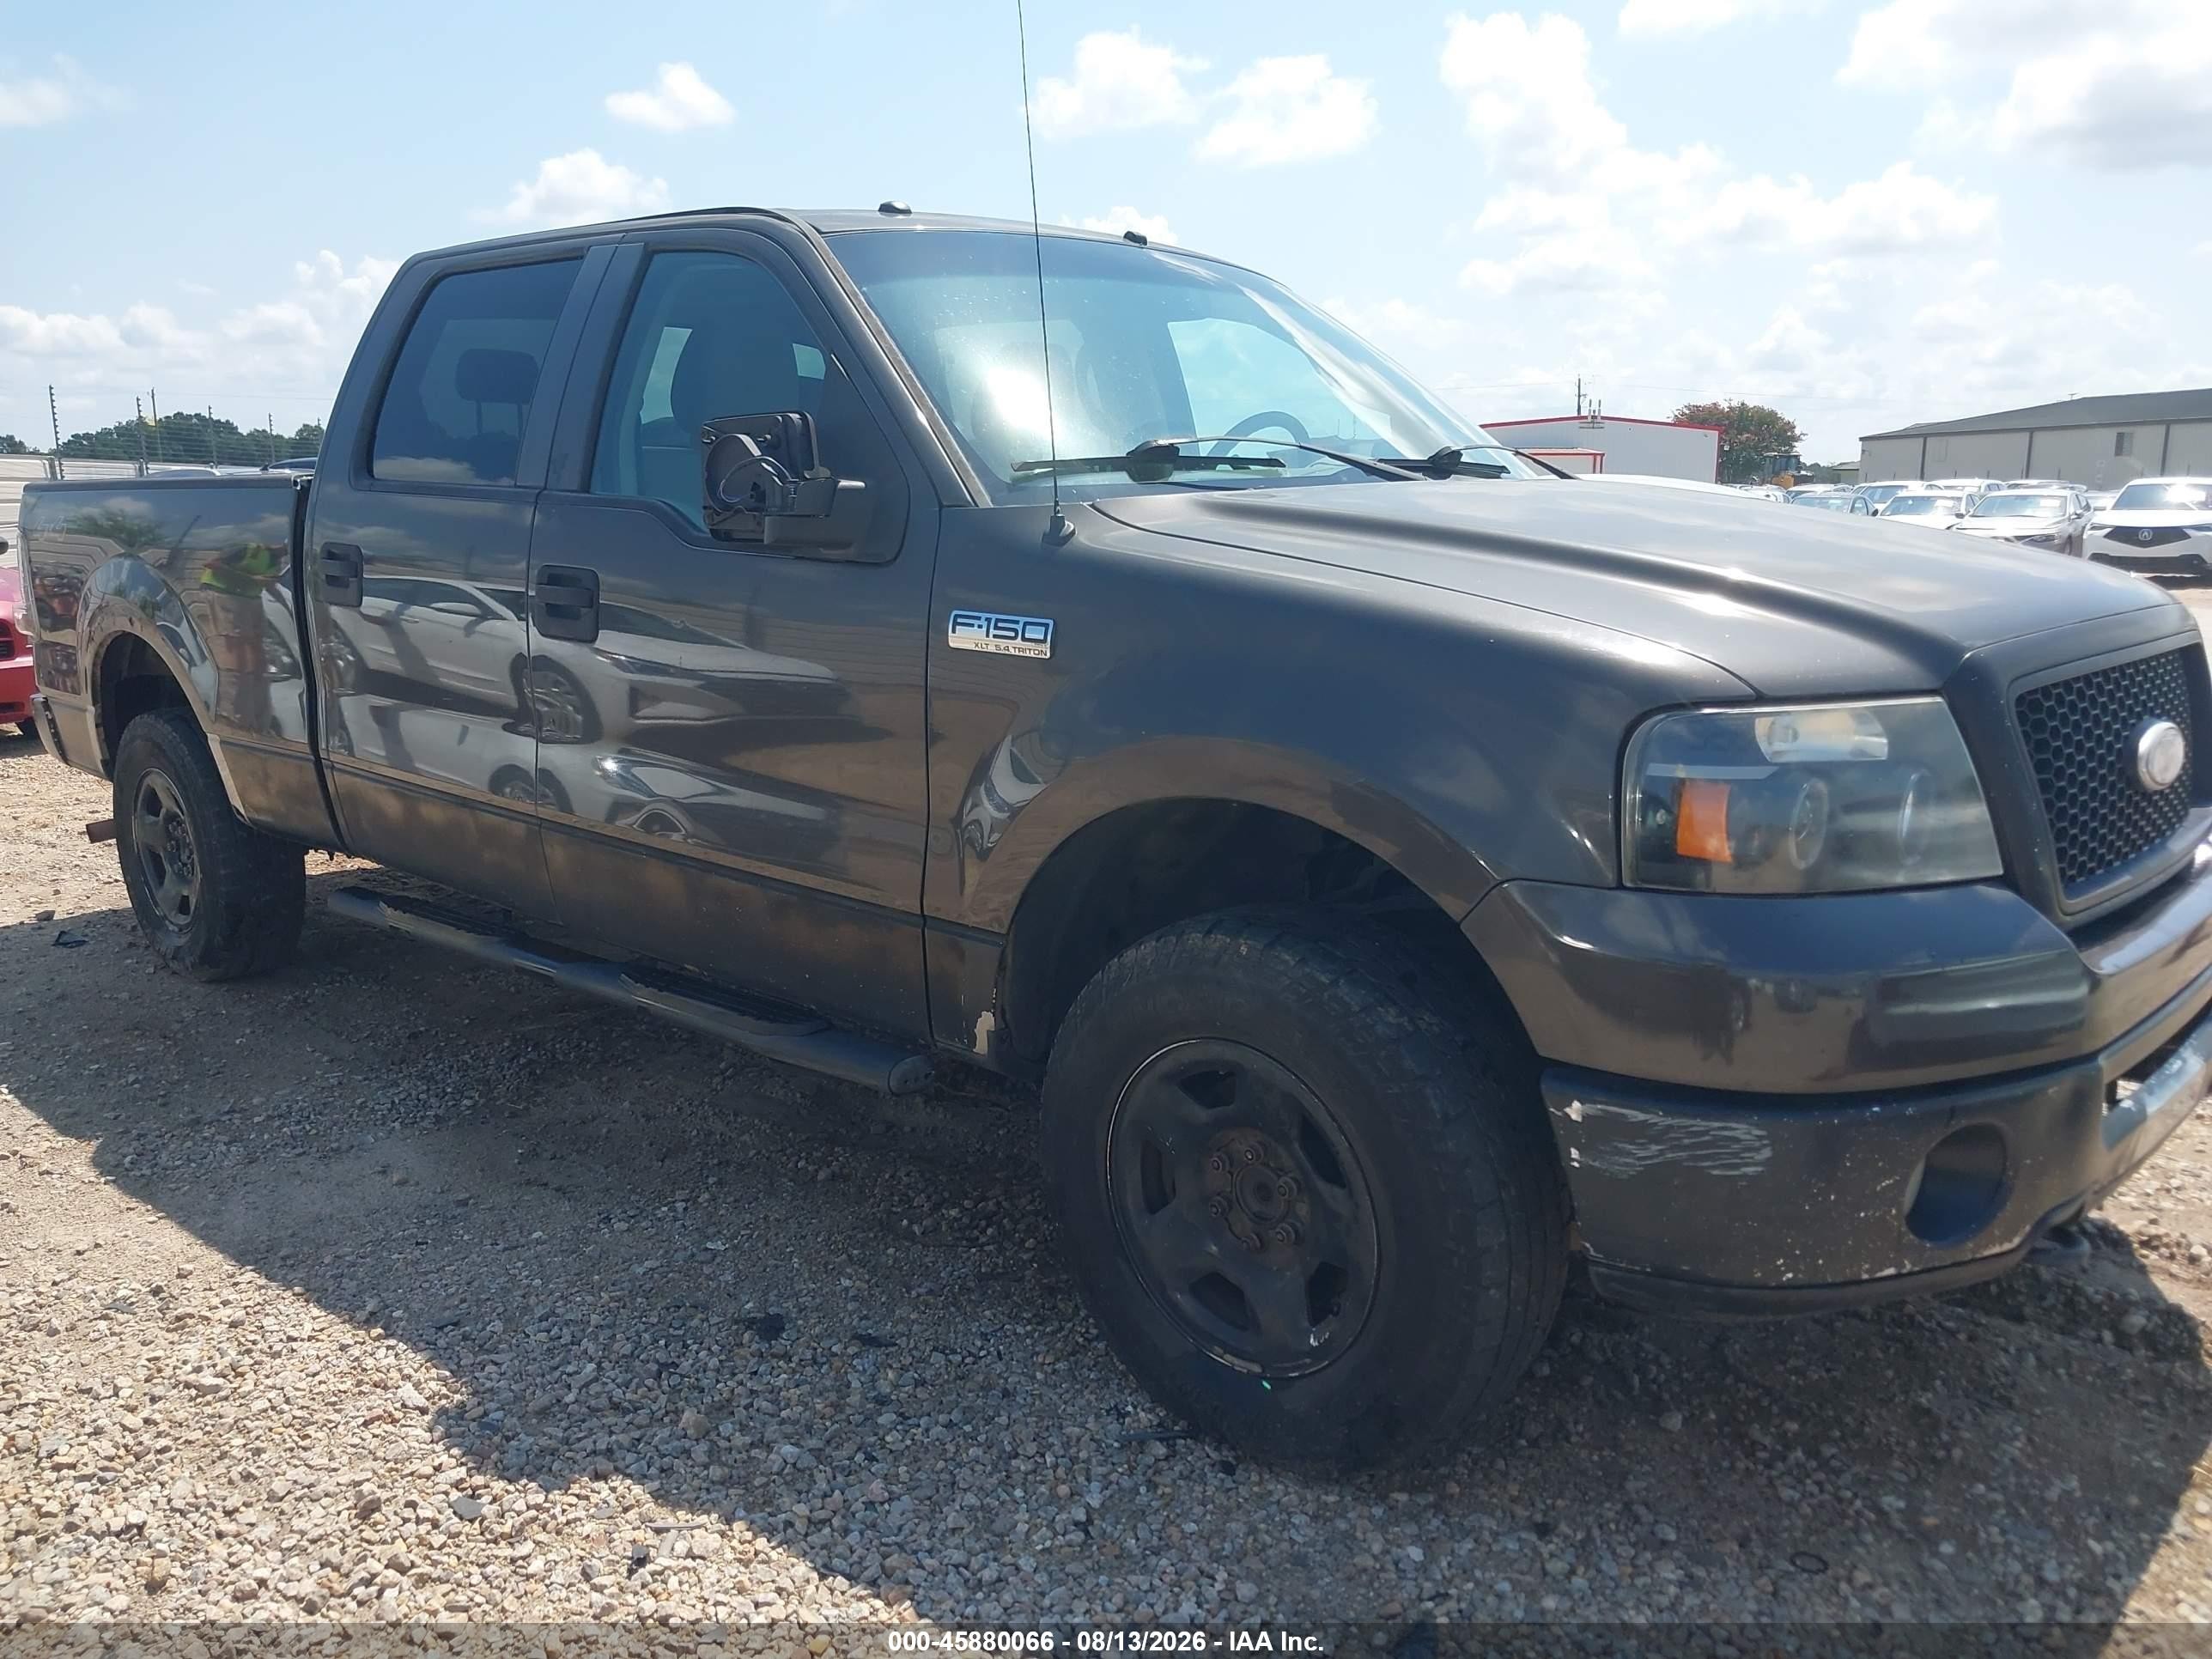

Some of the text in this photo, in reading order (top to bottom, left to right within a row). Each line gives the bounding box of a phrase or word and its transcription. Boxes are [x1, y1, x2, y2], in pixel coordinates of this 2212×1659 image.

[974, 641, 1048, 657] XLT 5.4 TRITON
